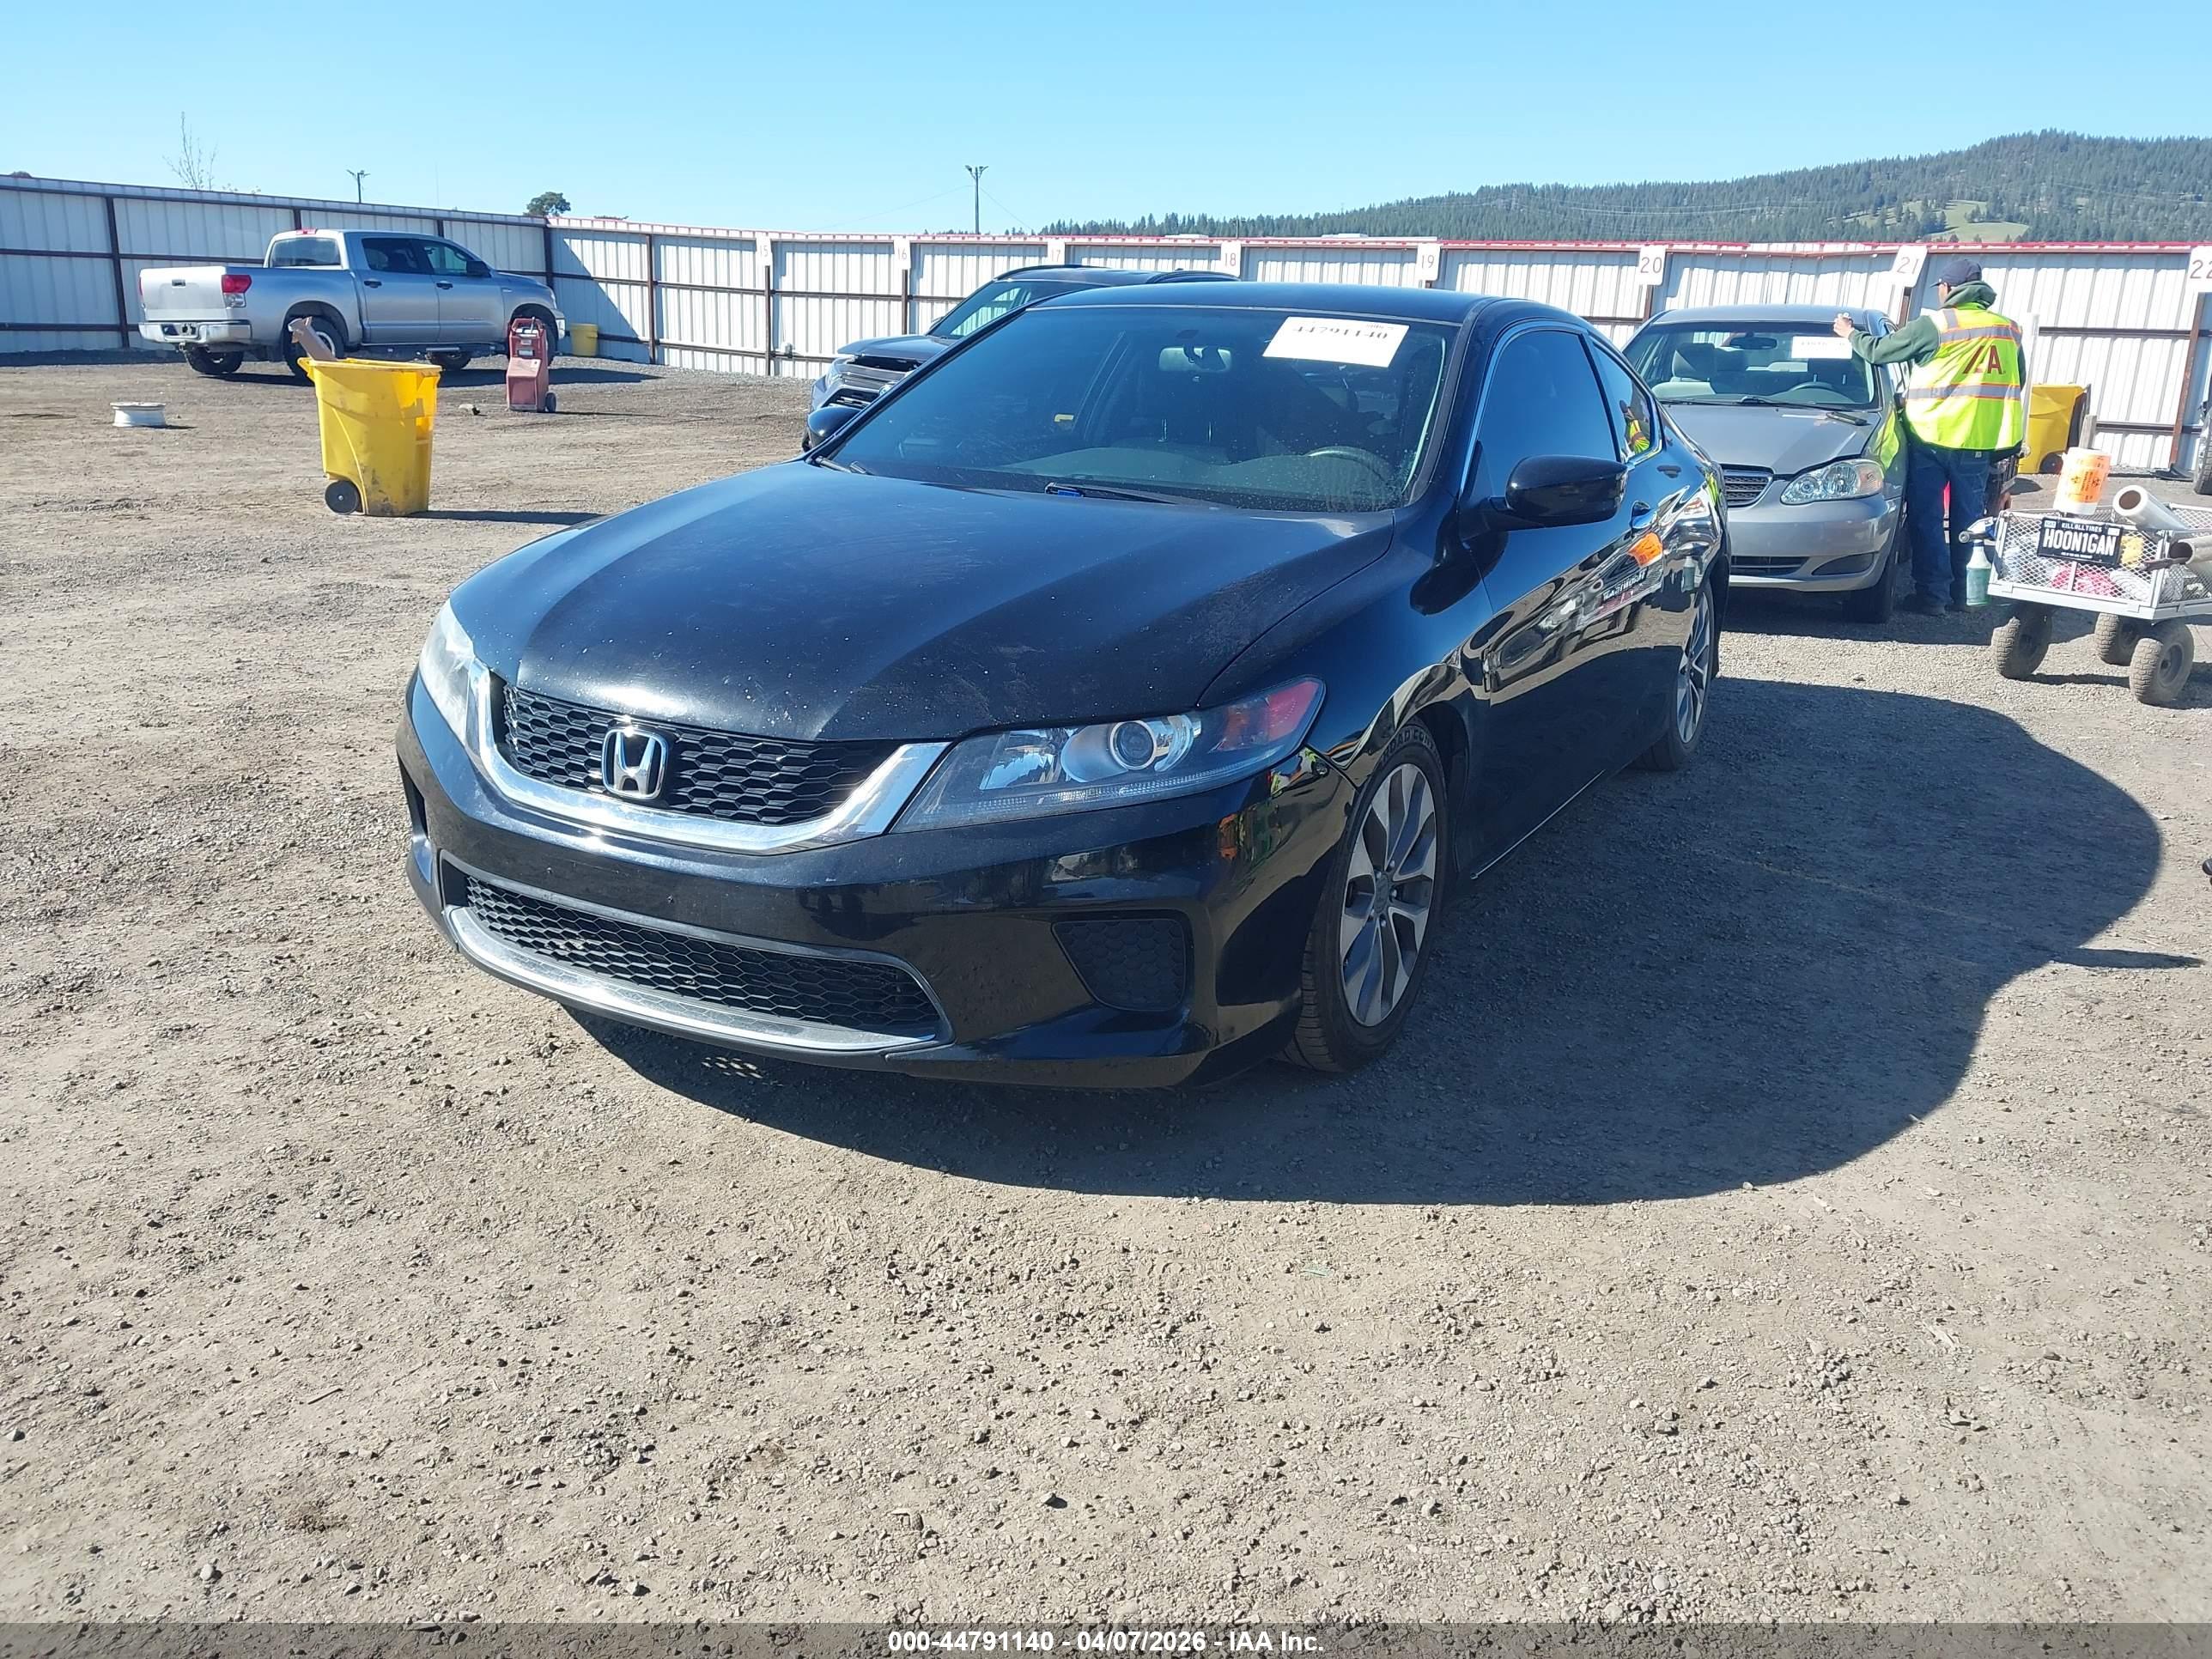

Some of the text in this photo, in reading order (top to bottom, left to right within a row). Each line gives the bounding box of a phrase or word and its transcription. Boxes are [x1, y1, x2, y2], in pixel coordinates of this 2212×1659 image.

[759, 245, 769, 257] 15
[897, 246, 908, 260] 16
[1051, 247, 1061, 262] 17
[1224, 252, 1237, 267] 18
[1421, 254, 1435, 269] 19
[1640, 256, 1662, 274] 20
[1896, 256, 1919, 275] 21
[2043, 528, 2117, 556] HOON1GAN
